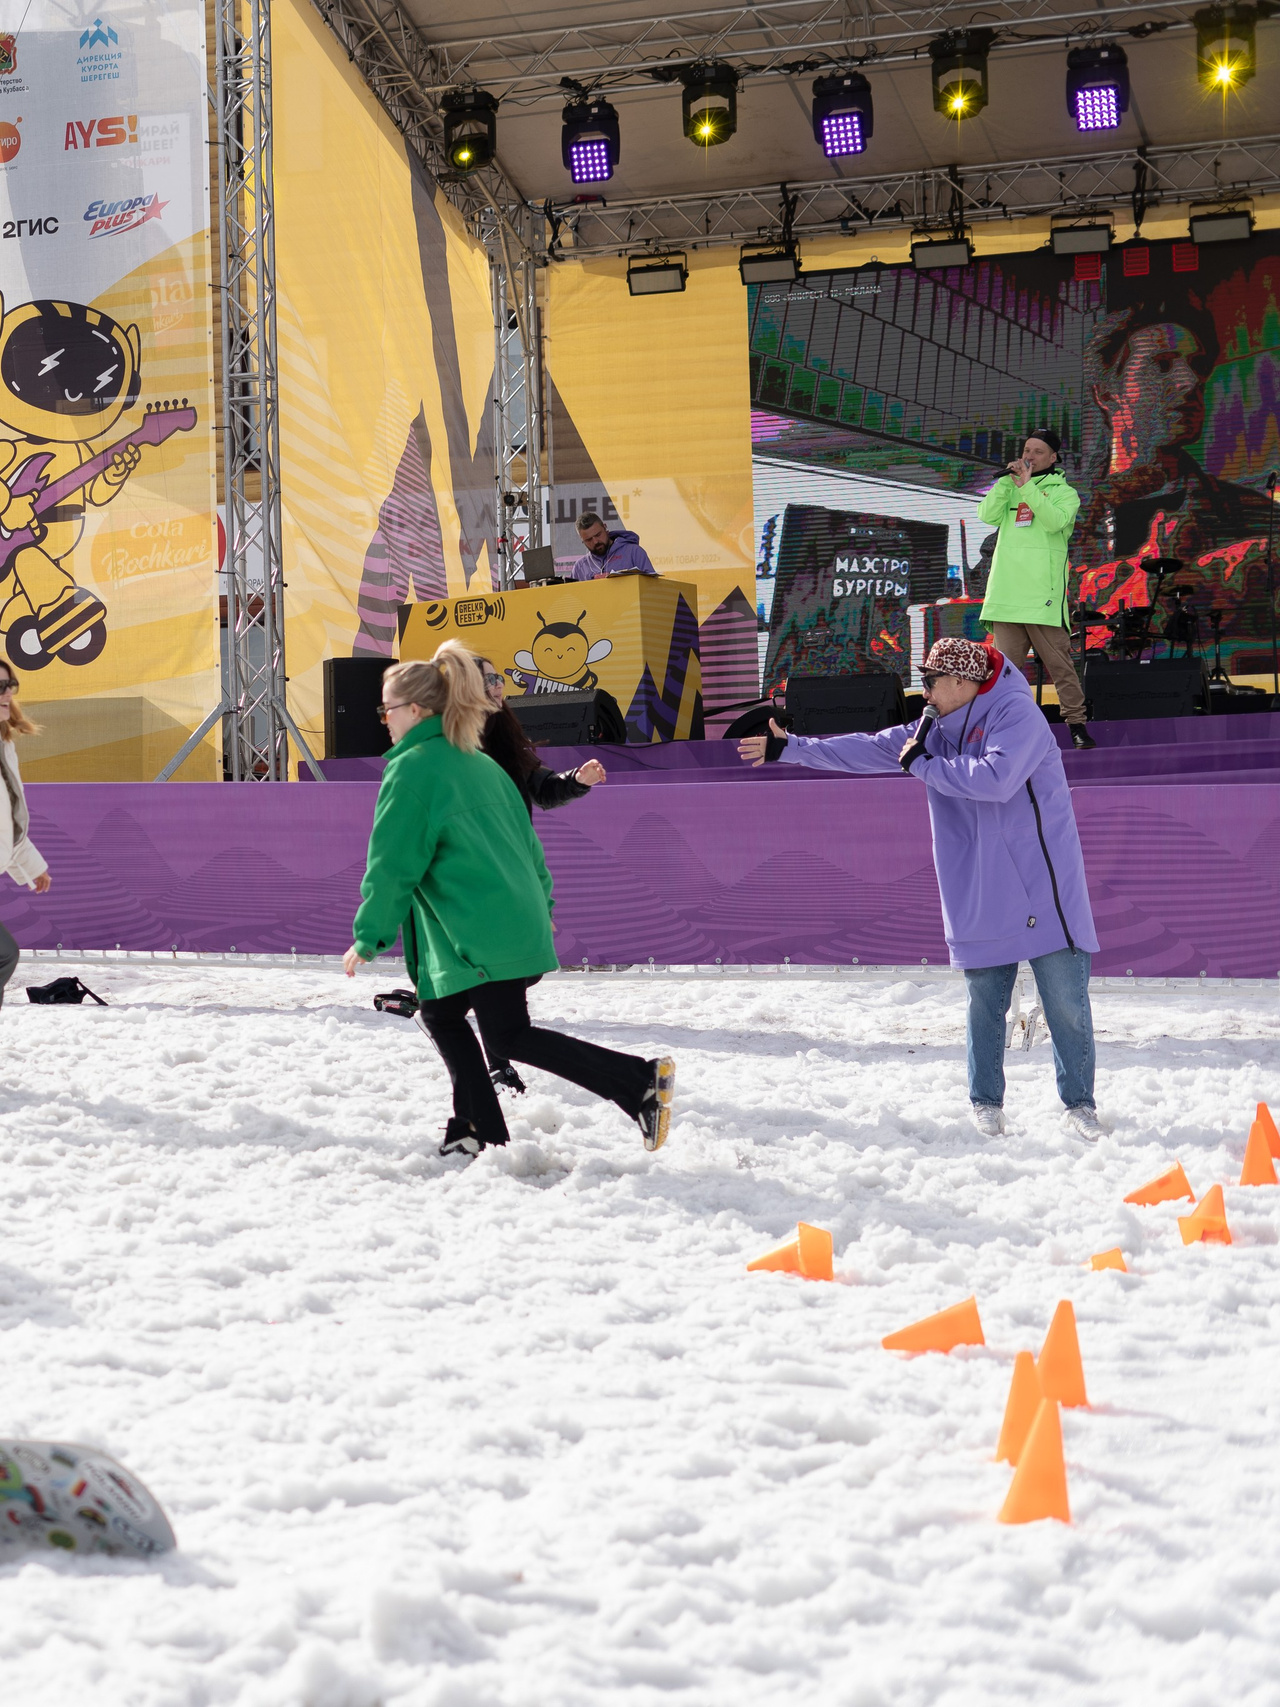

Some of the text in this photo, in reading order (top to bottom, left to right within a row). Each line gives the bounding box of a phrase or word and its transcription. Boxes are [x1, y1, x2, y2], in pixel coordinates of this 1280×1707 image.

[77, 52, 122, 65] ДИРЕКЦИЯ
[81, 63, 119, 73] КУРОРТА
[81, 72, 120, 83] ШЕРЕГЕШ
[64, 114, 138, 151] AYS!
[2, 216, 59, 239] 2ГИС
[835, 556, 909, 577] МАЭСТРО
[833, 578, 908, 598] БУРГЕРЫ
[458, 601, 484, 614] GRELKA
[459, 612, 476, 624] FEST
